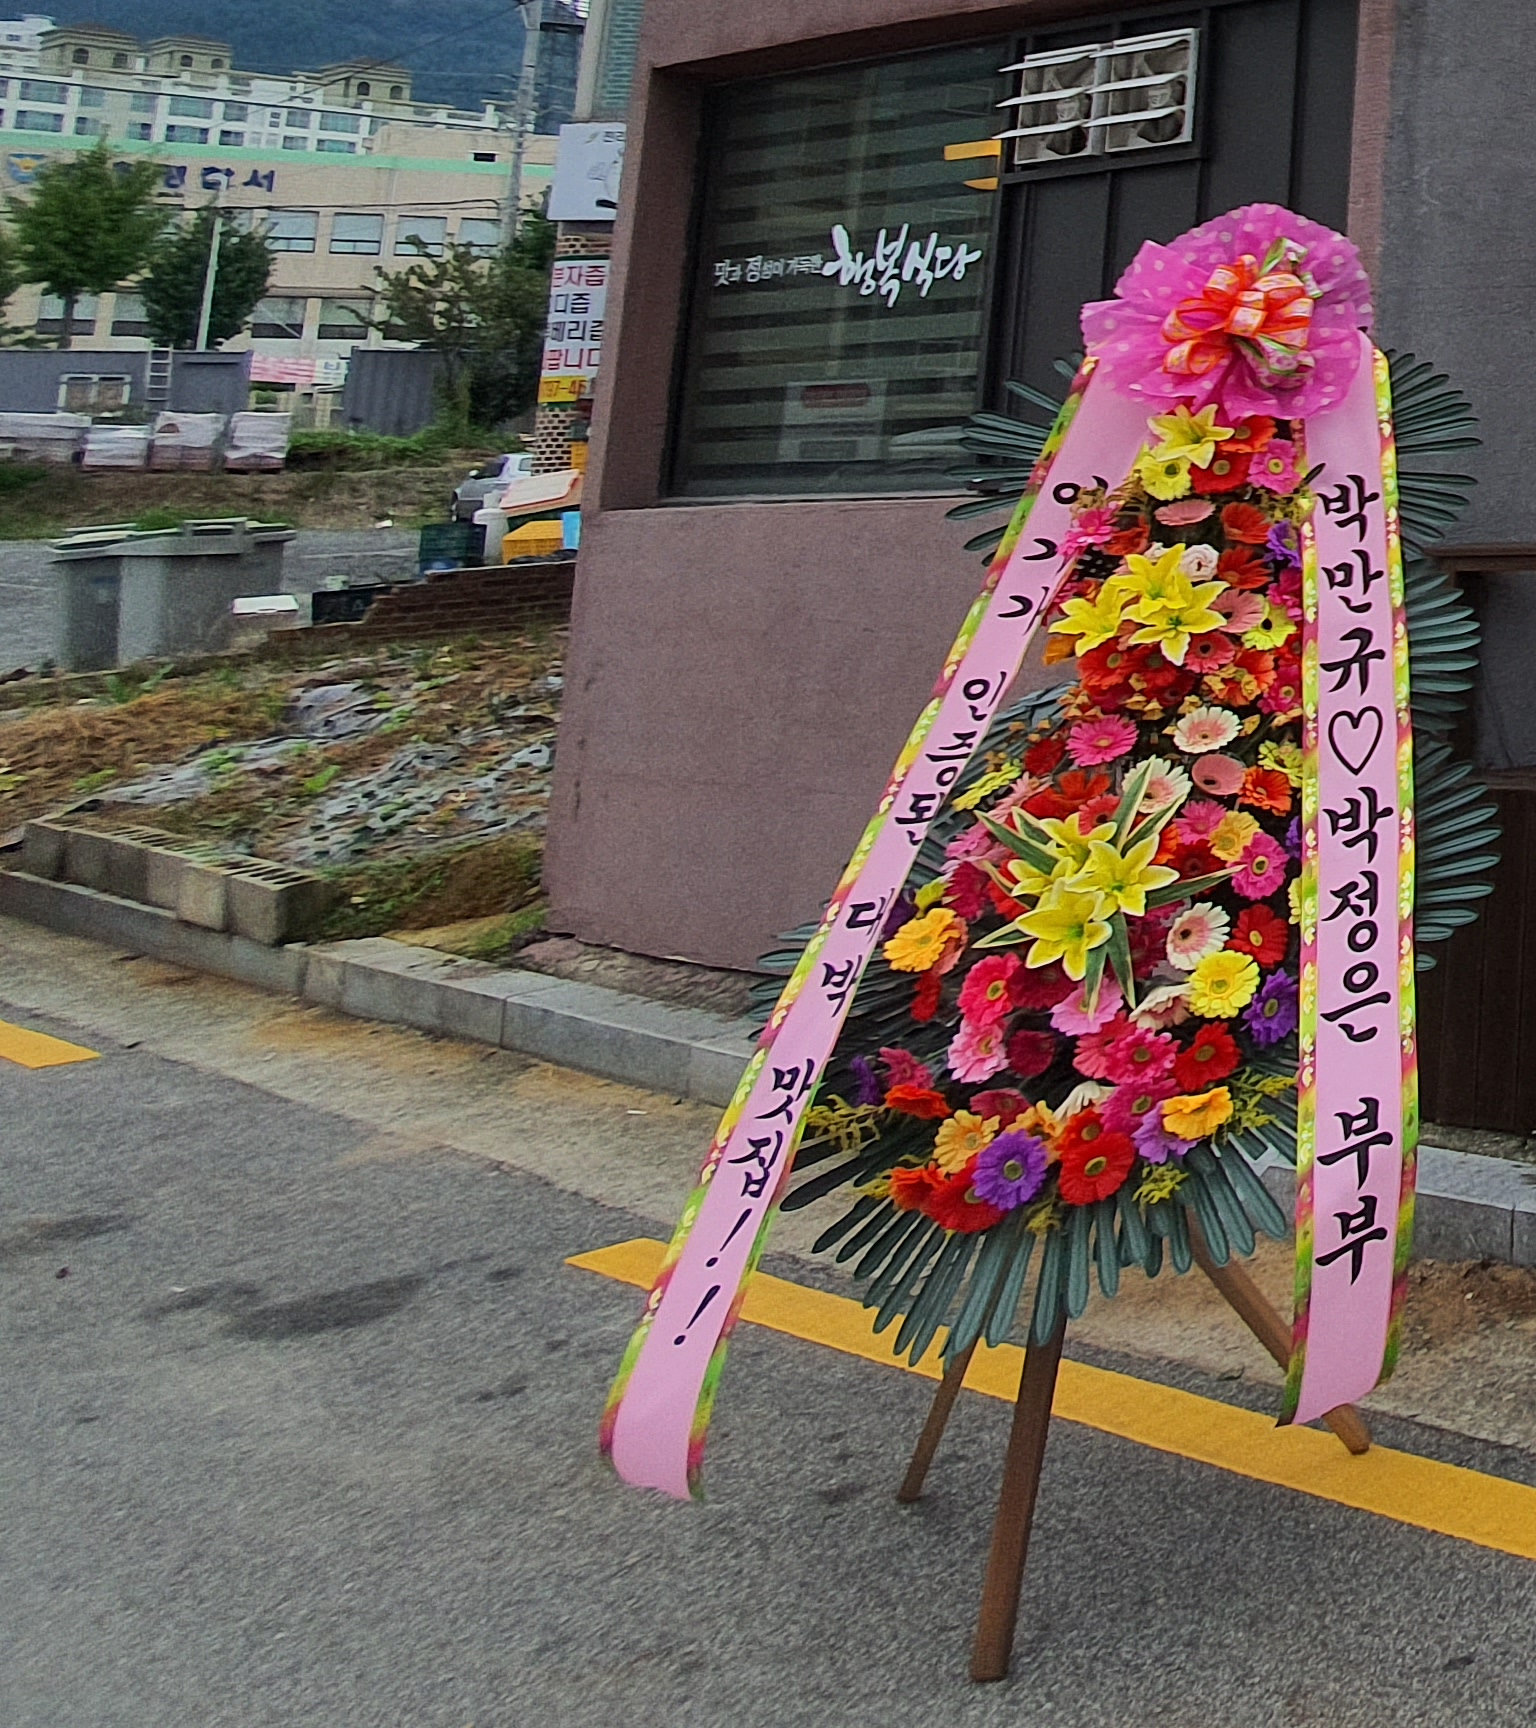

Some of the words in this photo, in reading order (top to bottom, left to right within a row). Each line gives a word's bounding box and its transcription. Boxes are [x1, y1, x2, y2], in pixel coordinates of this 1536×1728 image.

[821, 223, 982, 308] 행복식당
[895, 671, 1006, 846] 인증된
[821, 887, 896, 1018] 대박
[1315, 1097, 1394, 1286] 부부
